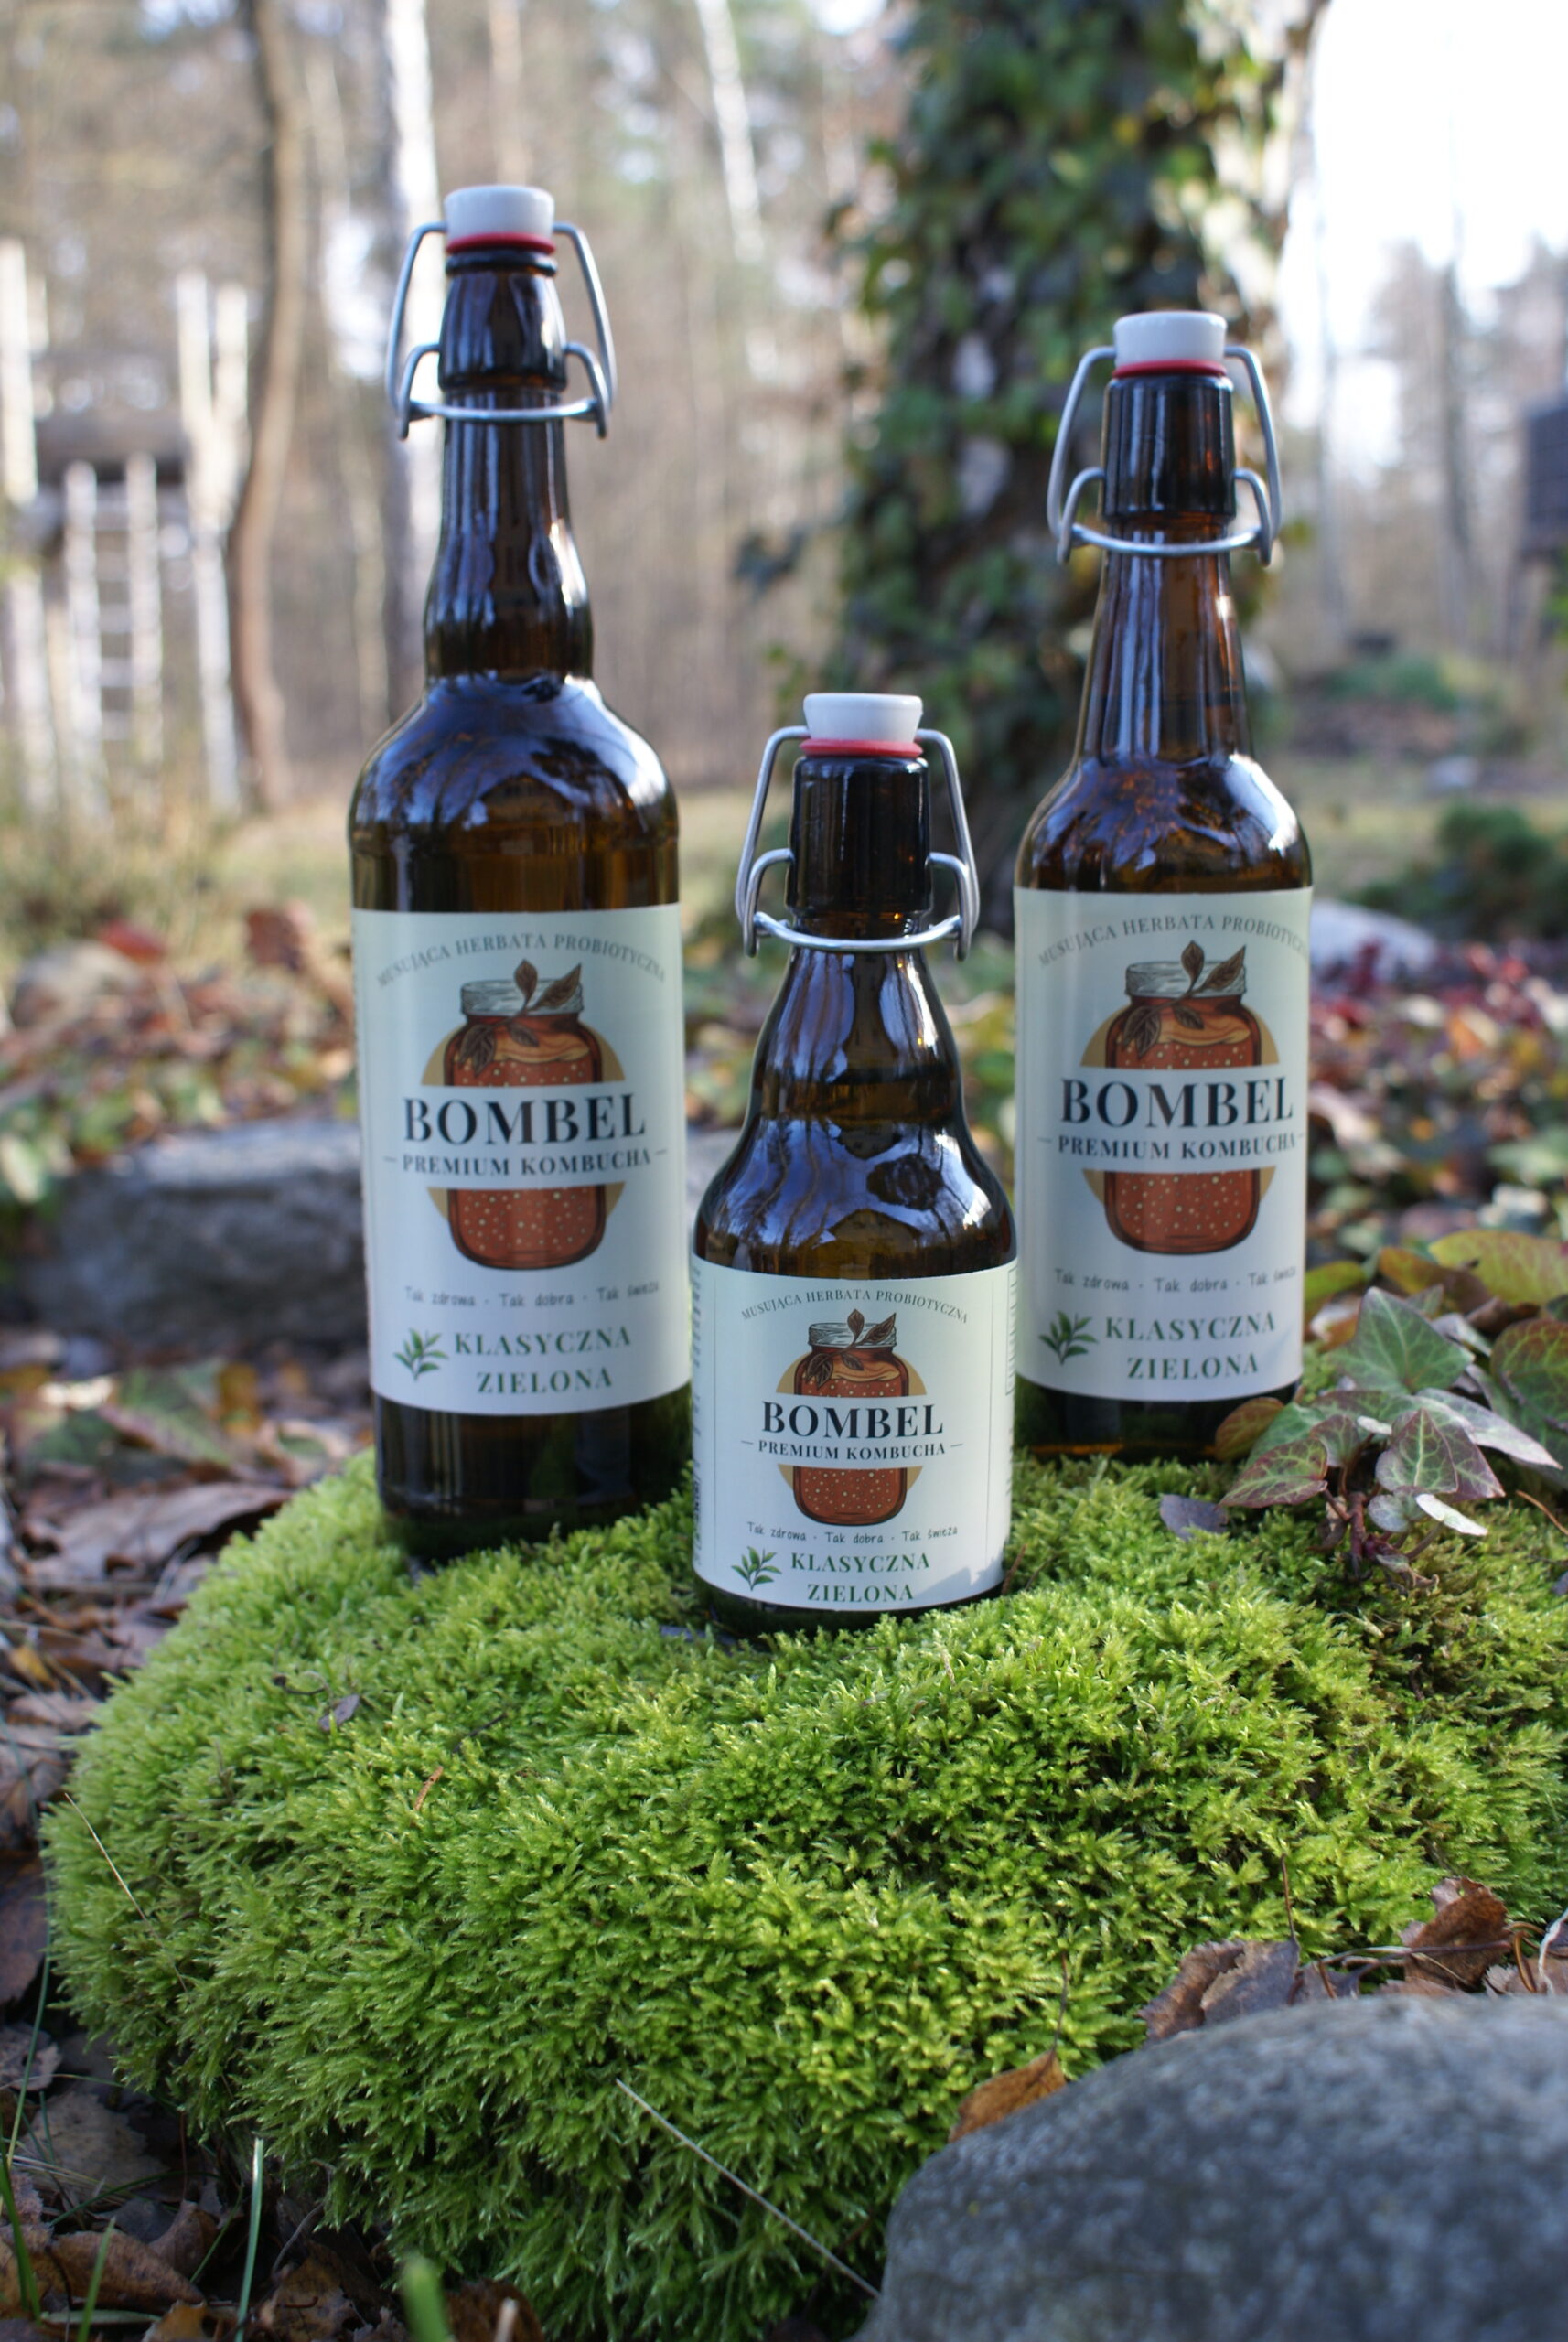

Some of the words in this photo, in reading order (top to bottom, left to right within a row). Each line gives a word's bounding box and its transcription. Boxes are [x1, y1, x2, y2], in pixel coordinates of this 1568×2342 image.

[1122, 915, 1215, 936] HERBATA
[456, 933, 547, 955] HERBATA
[1060, 1077, 1294, 1129] BOMBEL
[403, 1093, 646, 1145] BOMBEL
[1058, 1134, 1170, 1159] PREMIUM
[1181, 1132, 1295, 1159] KOMBUCHA
[403, 1154, 510, 1176] PREMIUM
[521, 1147, 651, 1176] KOMBUCHA
[1055, 1268, 1075, 1285] Tak
[1082, 1274, 1129, 1291] zdrowa
[1153, 1277, 1180, 1293] Tak
[1189, 1276, 1228, 1292] dobra
[1248, 1272, 1269, 1287] Tak
[405, 1286, 424, 1302] Tak
[432, 1289, 476, 1306] zdrowa
[499, 1293, 525, 1307] Tak
[535, 1292, 575, 1306] dobra
[596, 1286, 618, 1302] Tak
[806, 1288, 871, 1303] HERBATA
[875, 1289, 968, 1324] PROBIOTYCZNA
[1105, 1311, 1275, 1341] KLASYCZNA
[455, 1325, 631, 1356] KLASYCZNA
[1127, 1353, 1259, 1380] ZIELONA
[477, 1367, 613, 1394] ZIELONA
[762, 1401, 943, 1439] BOMBEL
[758, 1439, 839, 1460] PREMIUM
[846, 1442, 946, 1461] KOMBUCHA
[746, 1521, 765, 1535] Tak
[770, 1527, 807, 1542] zdrowa
[824, 1531, 845, 1543] Tak
[853, 1531, 884, 1544] dobra
[901, 1530, 921, 1542] Tak
[791, 1552, 930, 1574] KLASYCZNA
[808, 1584, 914, 1603] ZIELONA
